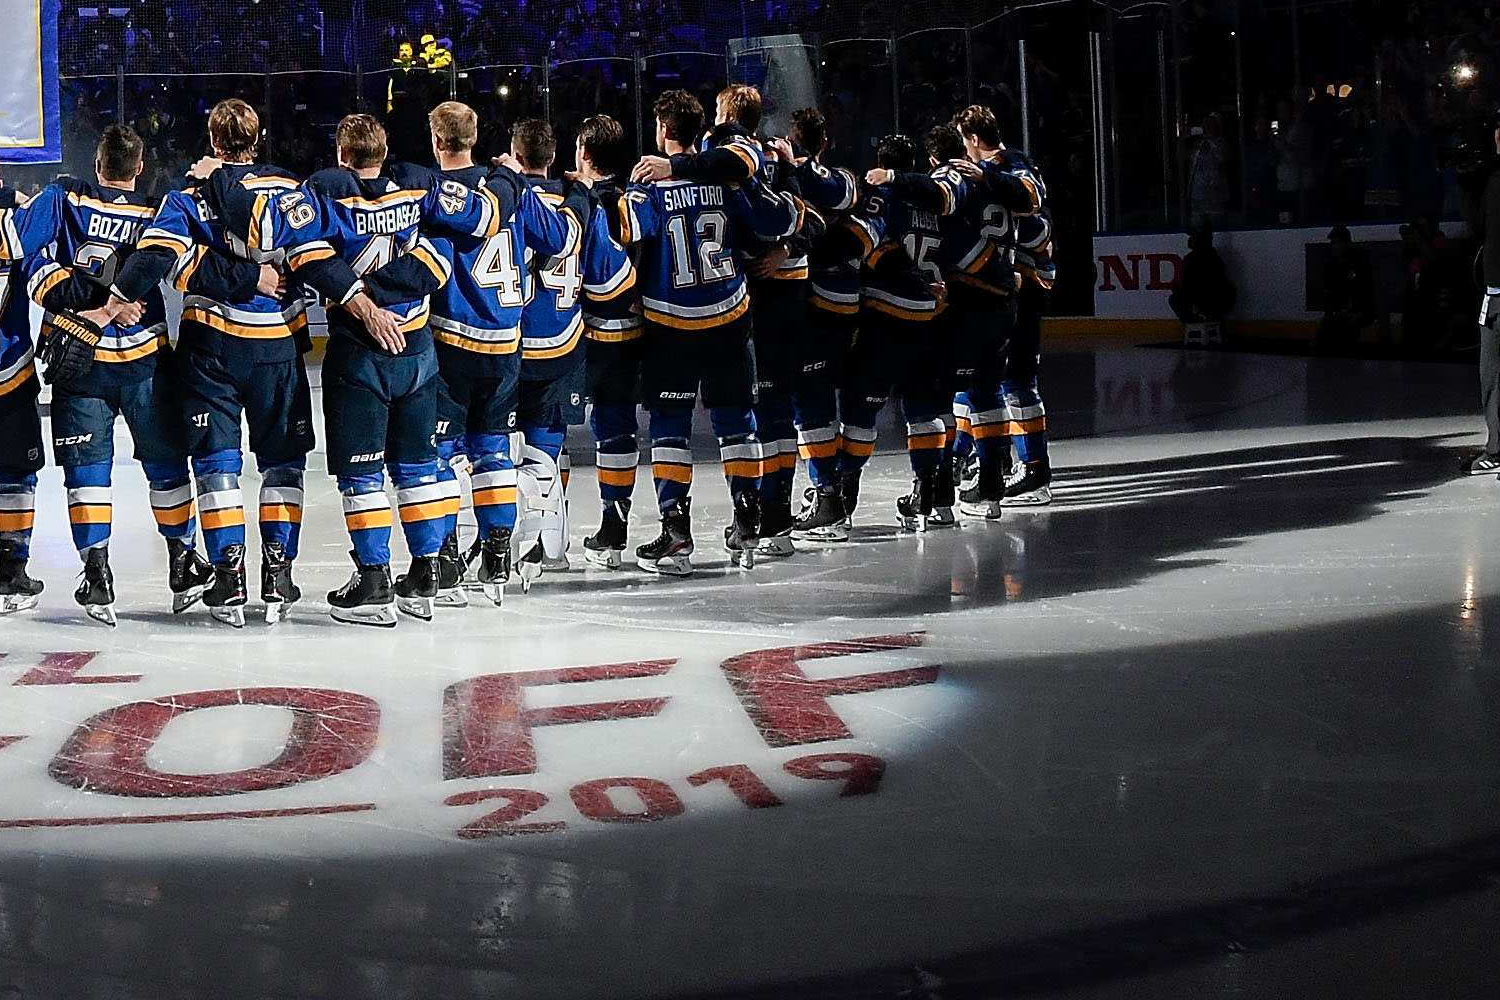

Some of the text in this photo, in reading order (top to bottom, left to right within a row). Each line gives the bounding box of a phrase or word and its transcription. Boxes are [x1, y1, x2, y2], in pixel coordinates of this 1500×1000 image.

[663, 184, 724, 212] SANFORD
[665, 210, 737, 289] 12
[55, 433, 93, 446] CCM
[442, 751, 889, 840] 2019
